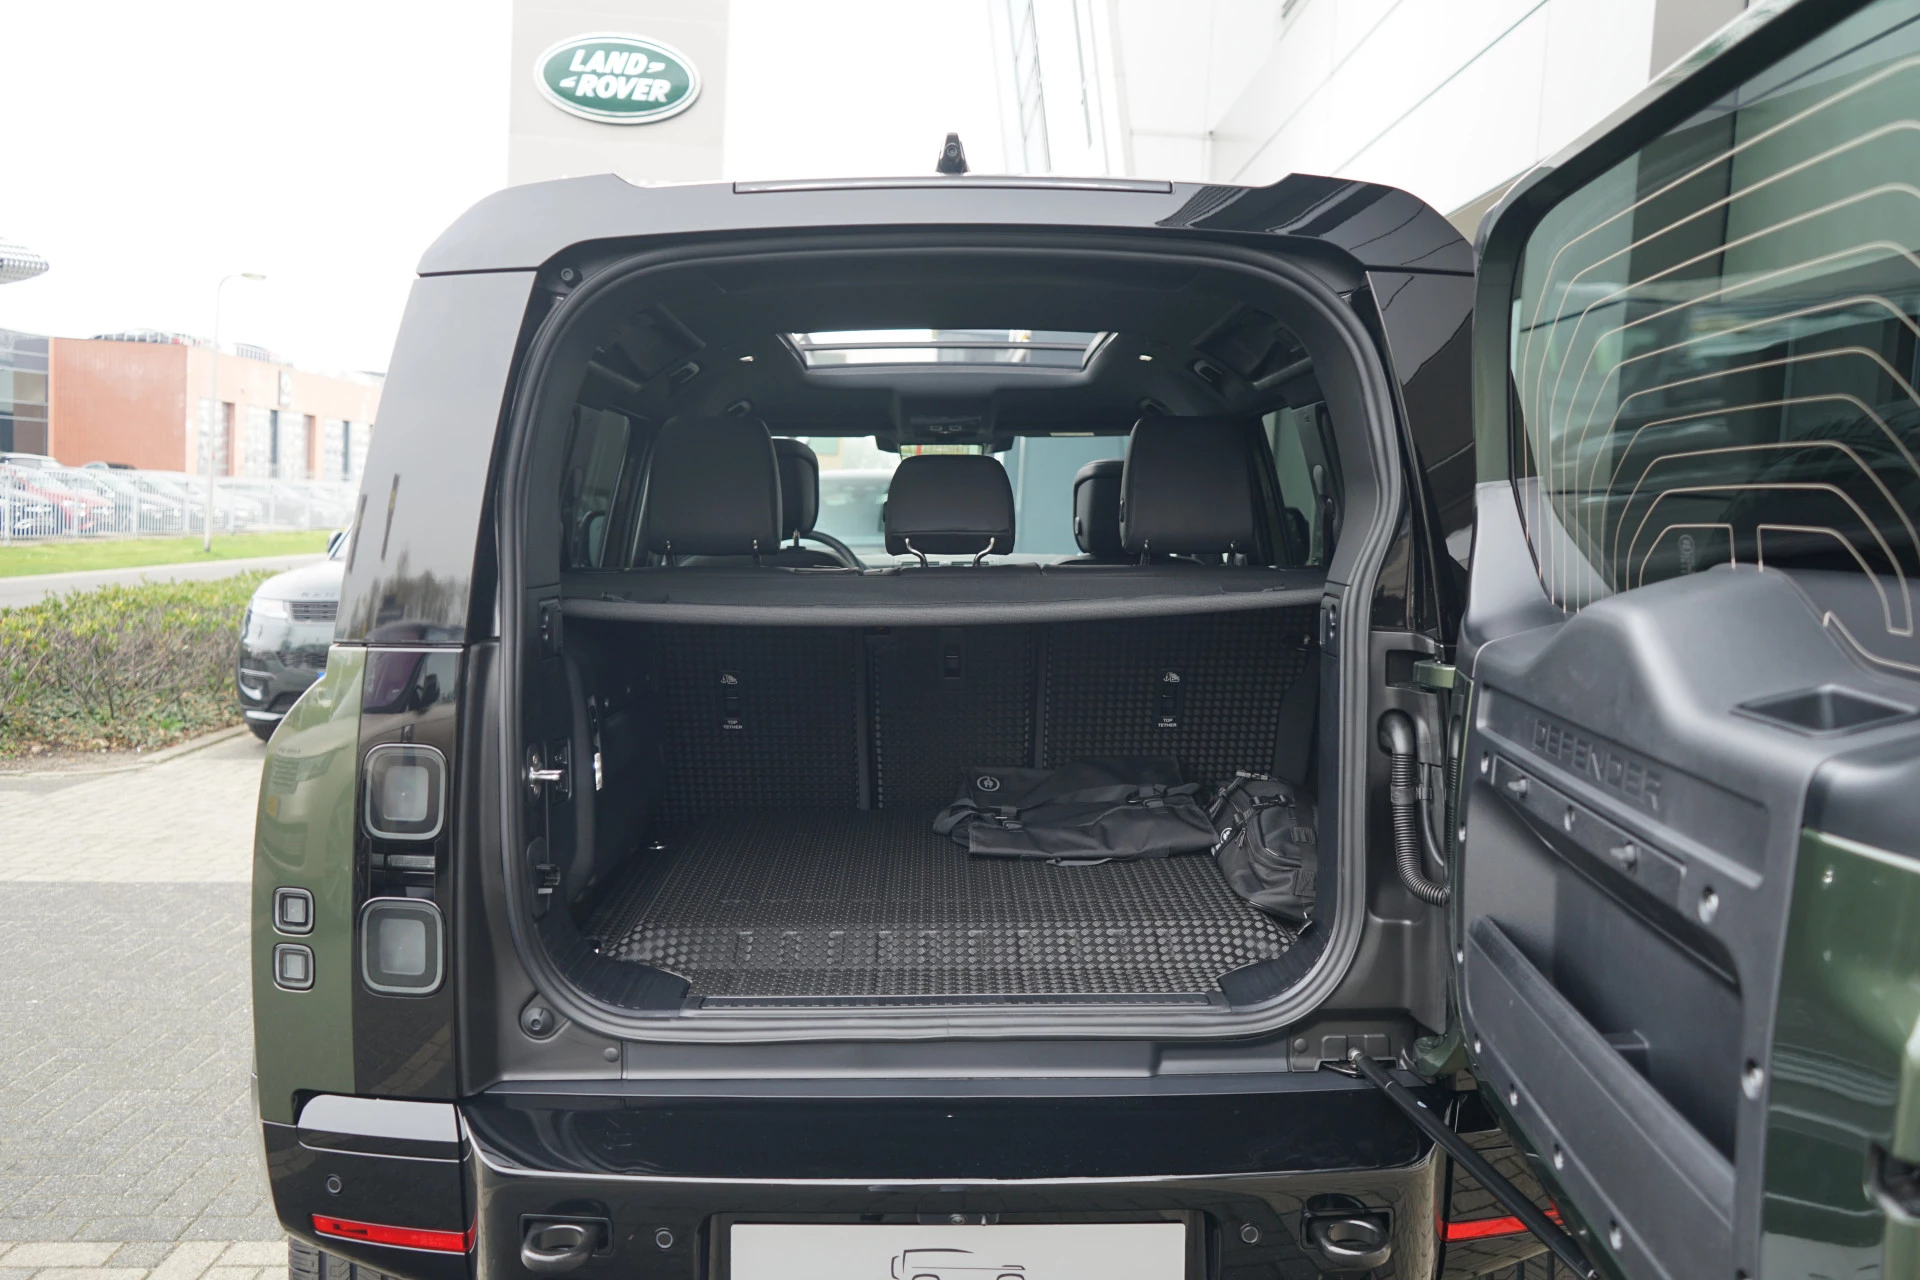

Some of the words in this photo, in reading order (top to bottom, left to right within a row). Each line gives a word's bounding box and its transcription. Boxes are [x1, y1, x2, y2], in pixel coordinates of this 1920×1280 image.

[569, 49, 649, 76] LAND
[575, 74, 672, 102] ROVER
[1532, 719, 1662, 811] DEFENDER
